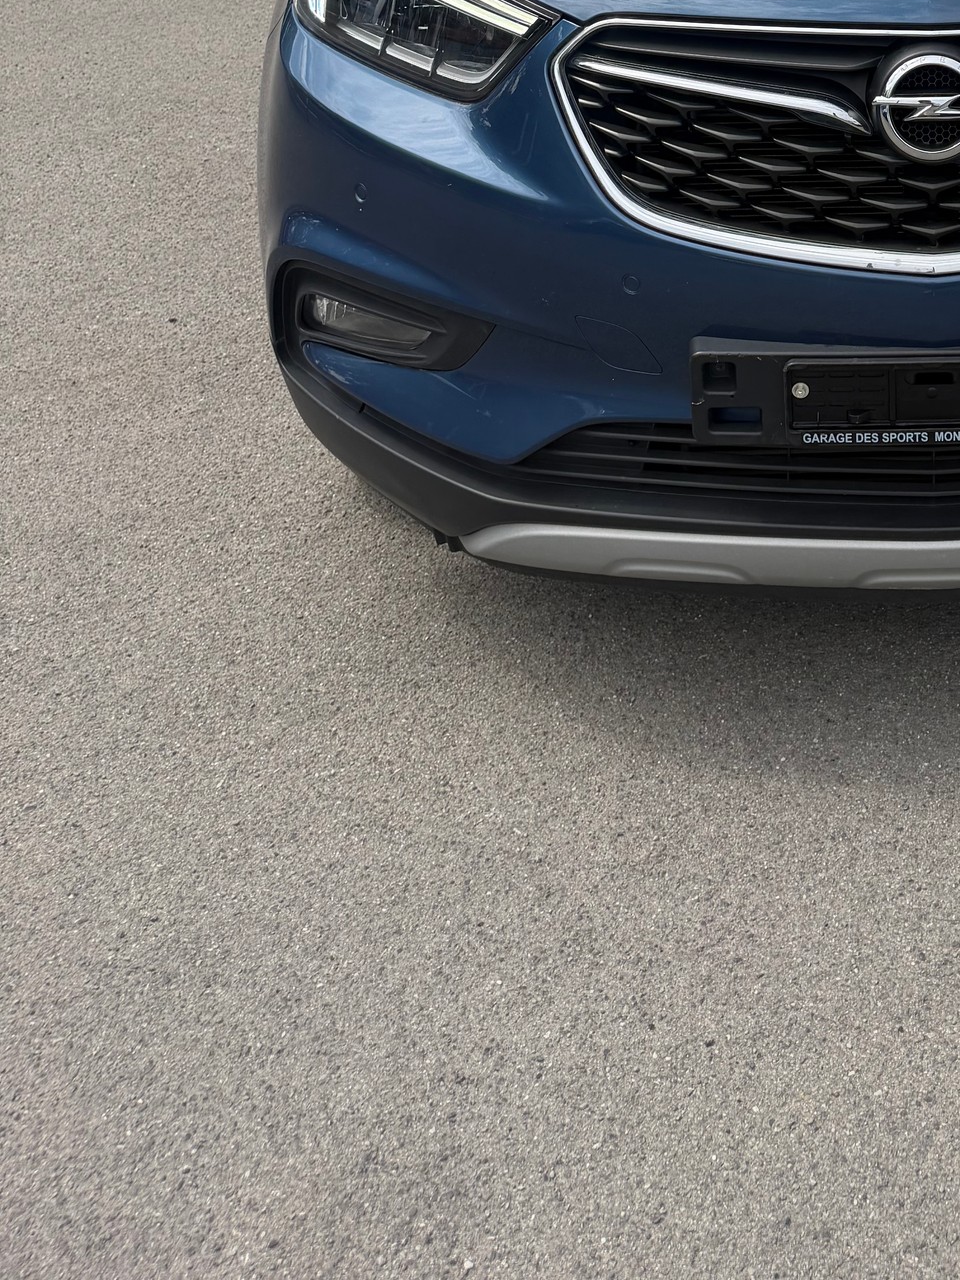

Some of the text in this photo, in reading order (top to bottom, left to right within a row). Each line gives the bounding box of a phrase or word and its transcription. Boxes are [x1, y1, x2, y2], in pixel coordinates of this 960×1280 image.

[803, 433, 853, 443] GARAGE
[855, 433, 879, 443] DES
[881, 432, 929, 443] SPORTS
